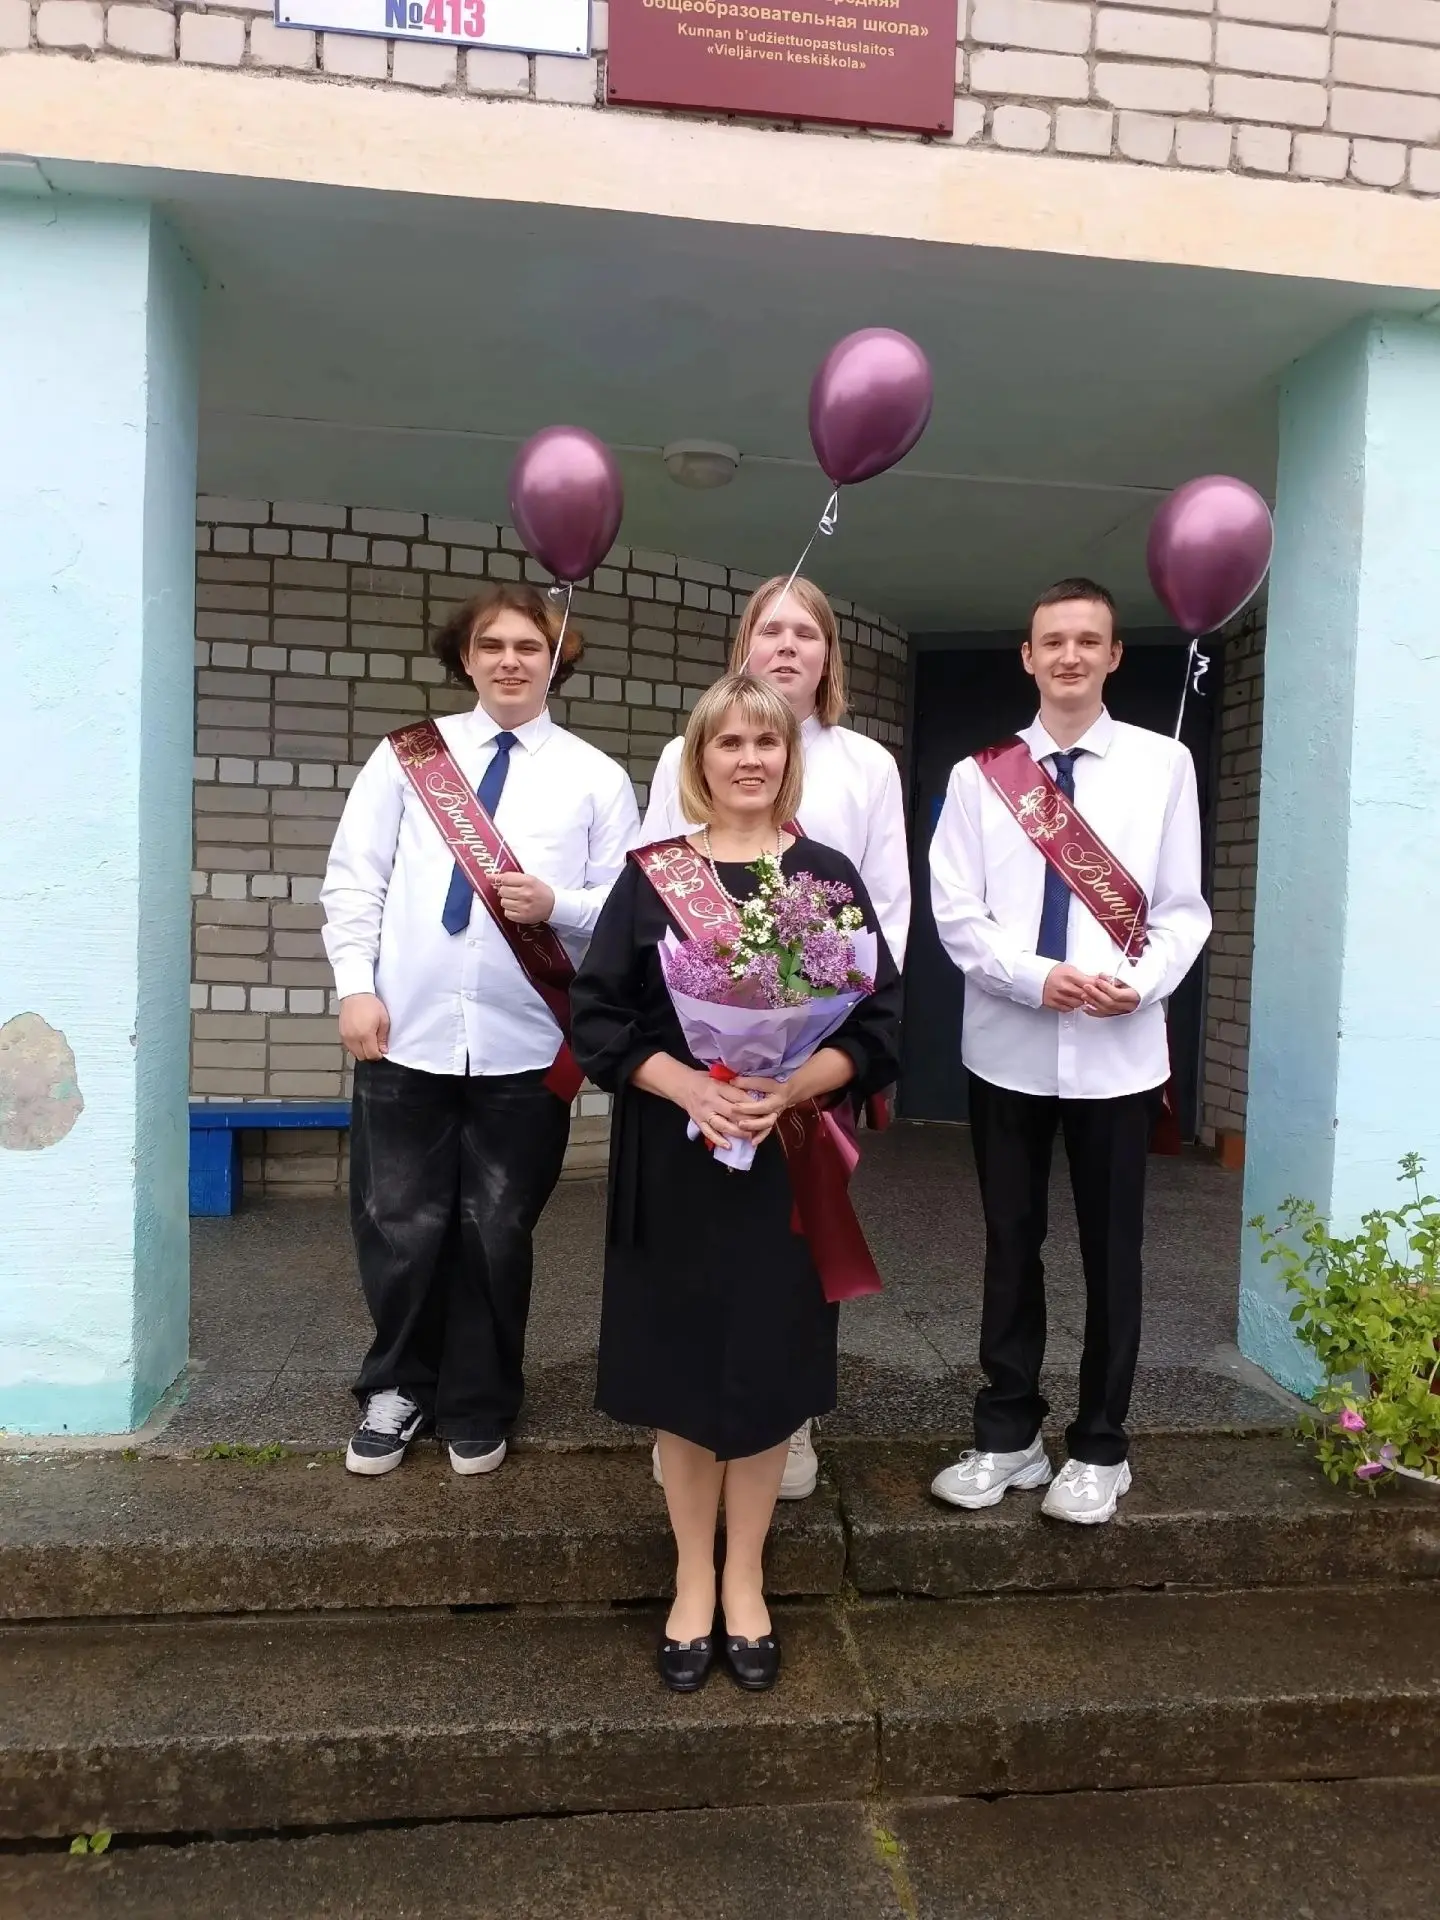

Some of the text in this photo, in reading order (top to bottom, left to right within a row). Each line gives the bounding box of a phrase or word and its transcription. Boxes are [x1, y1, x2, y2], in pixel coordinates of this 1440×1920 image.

[642, 0, 929, 37] общеобразовательная школа»
[677, 22, 731, 40] Kunnan
[707, 43, 866, 70] «Vieljärven keskiškola»
